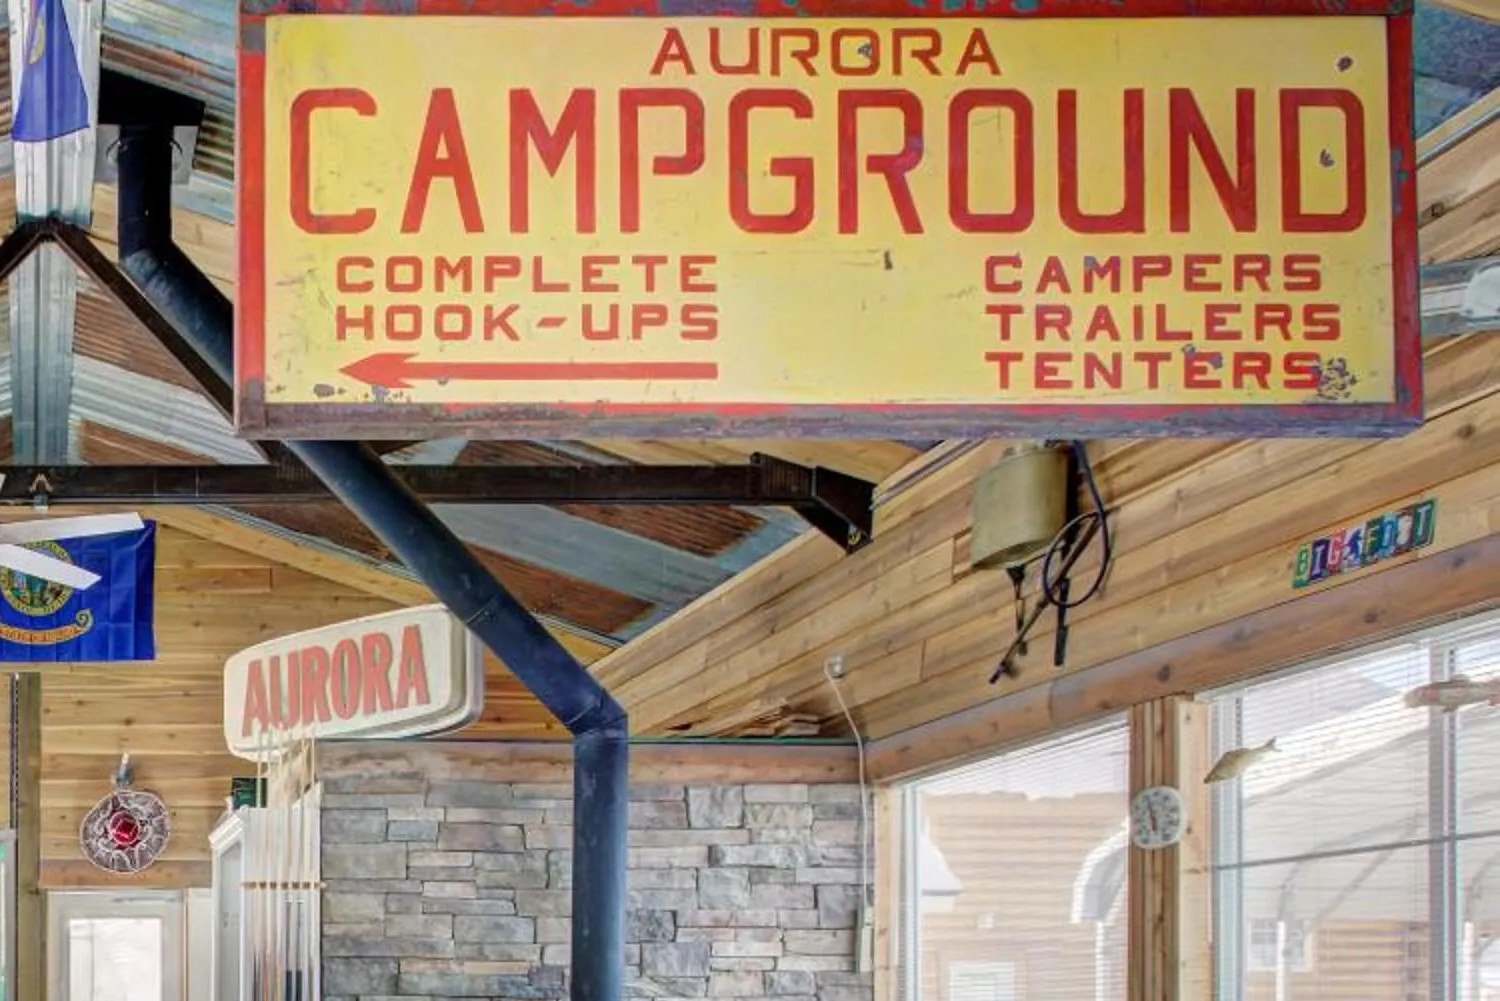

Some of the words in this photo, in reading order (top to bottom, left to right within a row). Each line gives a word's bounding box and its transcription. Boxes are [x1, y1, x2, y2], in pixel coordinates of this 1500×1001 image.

[649, 27, 1002, 77] AURORA
[289, 86, 1367, 236] CAMPGROUND
[335, 254, 718, 293] COMPLETE
[984, 253, 1323, 294] CAMPERS
[335, 303, 719, 341] HOOK-UPS
[984, 303, 1342, 341] TRAILERS
[984, 350, 1324, 390] TENTERS
[242, 623, 431, 738] AURORA
